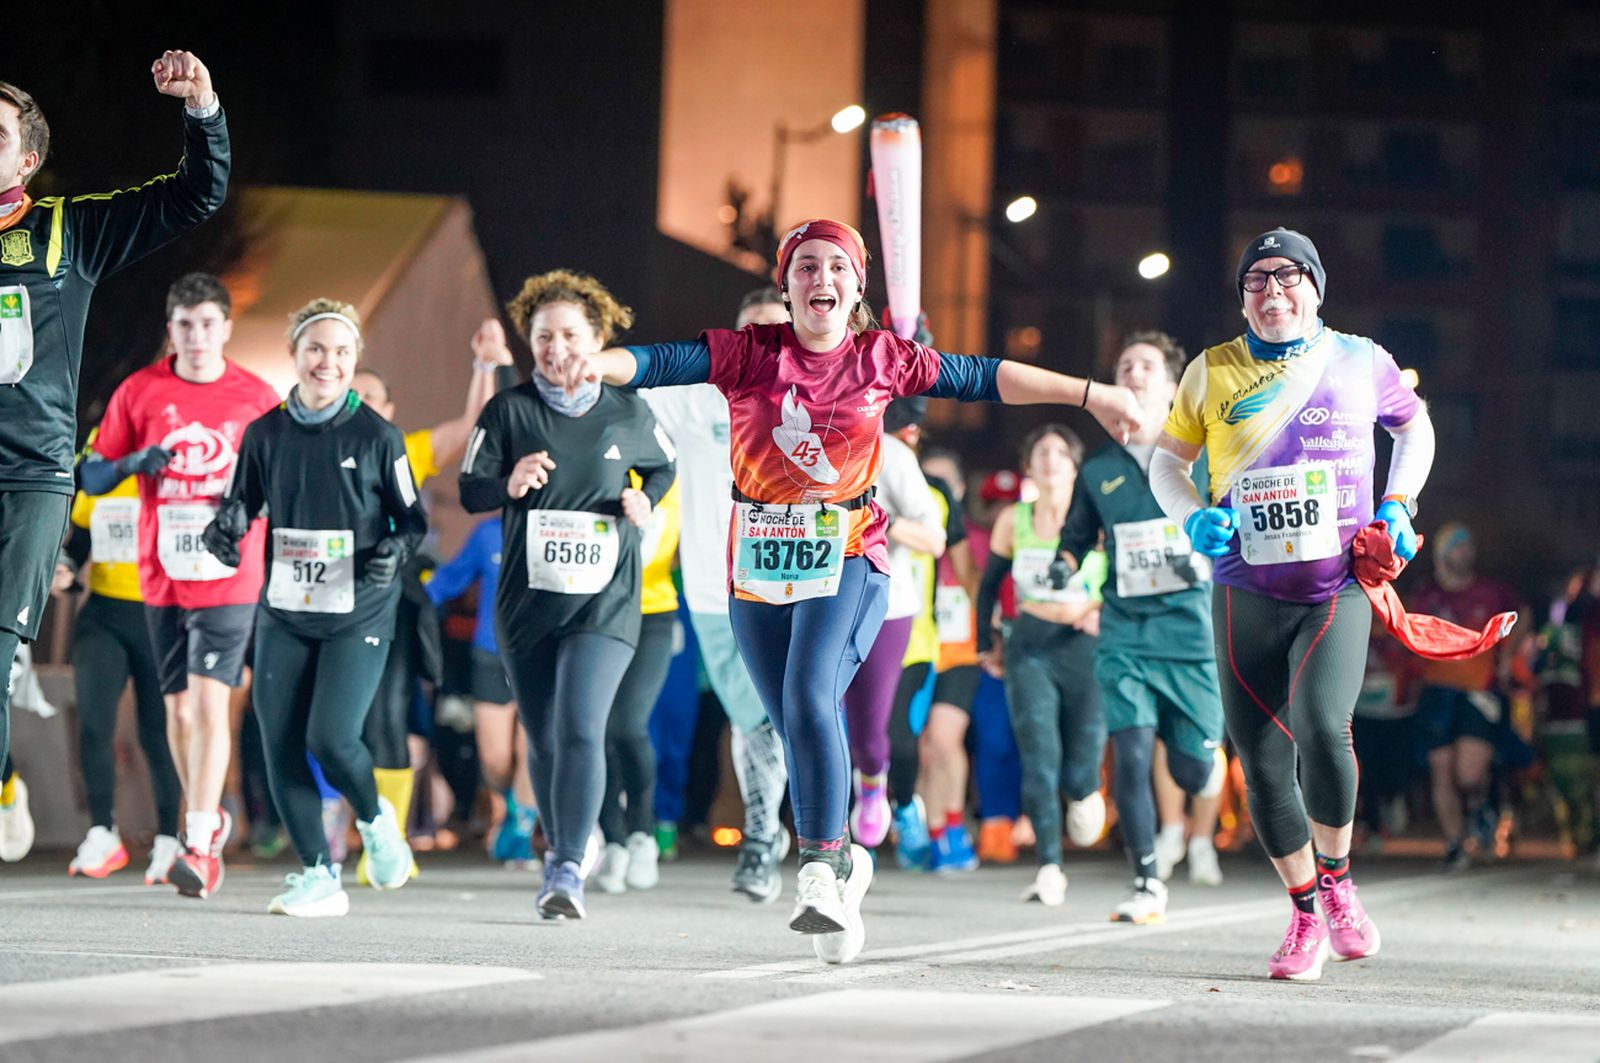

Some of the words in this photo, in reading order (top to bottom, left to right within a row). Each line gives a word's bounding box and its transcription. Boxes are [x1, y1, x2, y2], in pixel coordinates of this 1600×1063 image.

[791, 440, 821, 467] 43
[1252, 478, 1283, 490] NOCHE
[1284, 477, 1295, 486] DE
[1242, 493, 1261, 504] SAN
[1263, 487, 1297, 501] ANTÓN
[761, 514, 791, 525] NOCHE
[792, 515, 805, 525] DE
[1250, 499, 1319, 532] 5858
[748, 526, 767, 537] SAN
[769, 525, 806, 538] ANTÓN
[544, 540, 601, 565] 6588
[751, 540, 832, 571] 13762
[293, 560, 326, 583] 512
